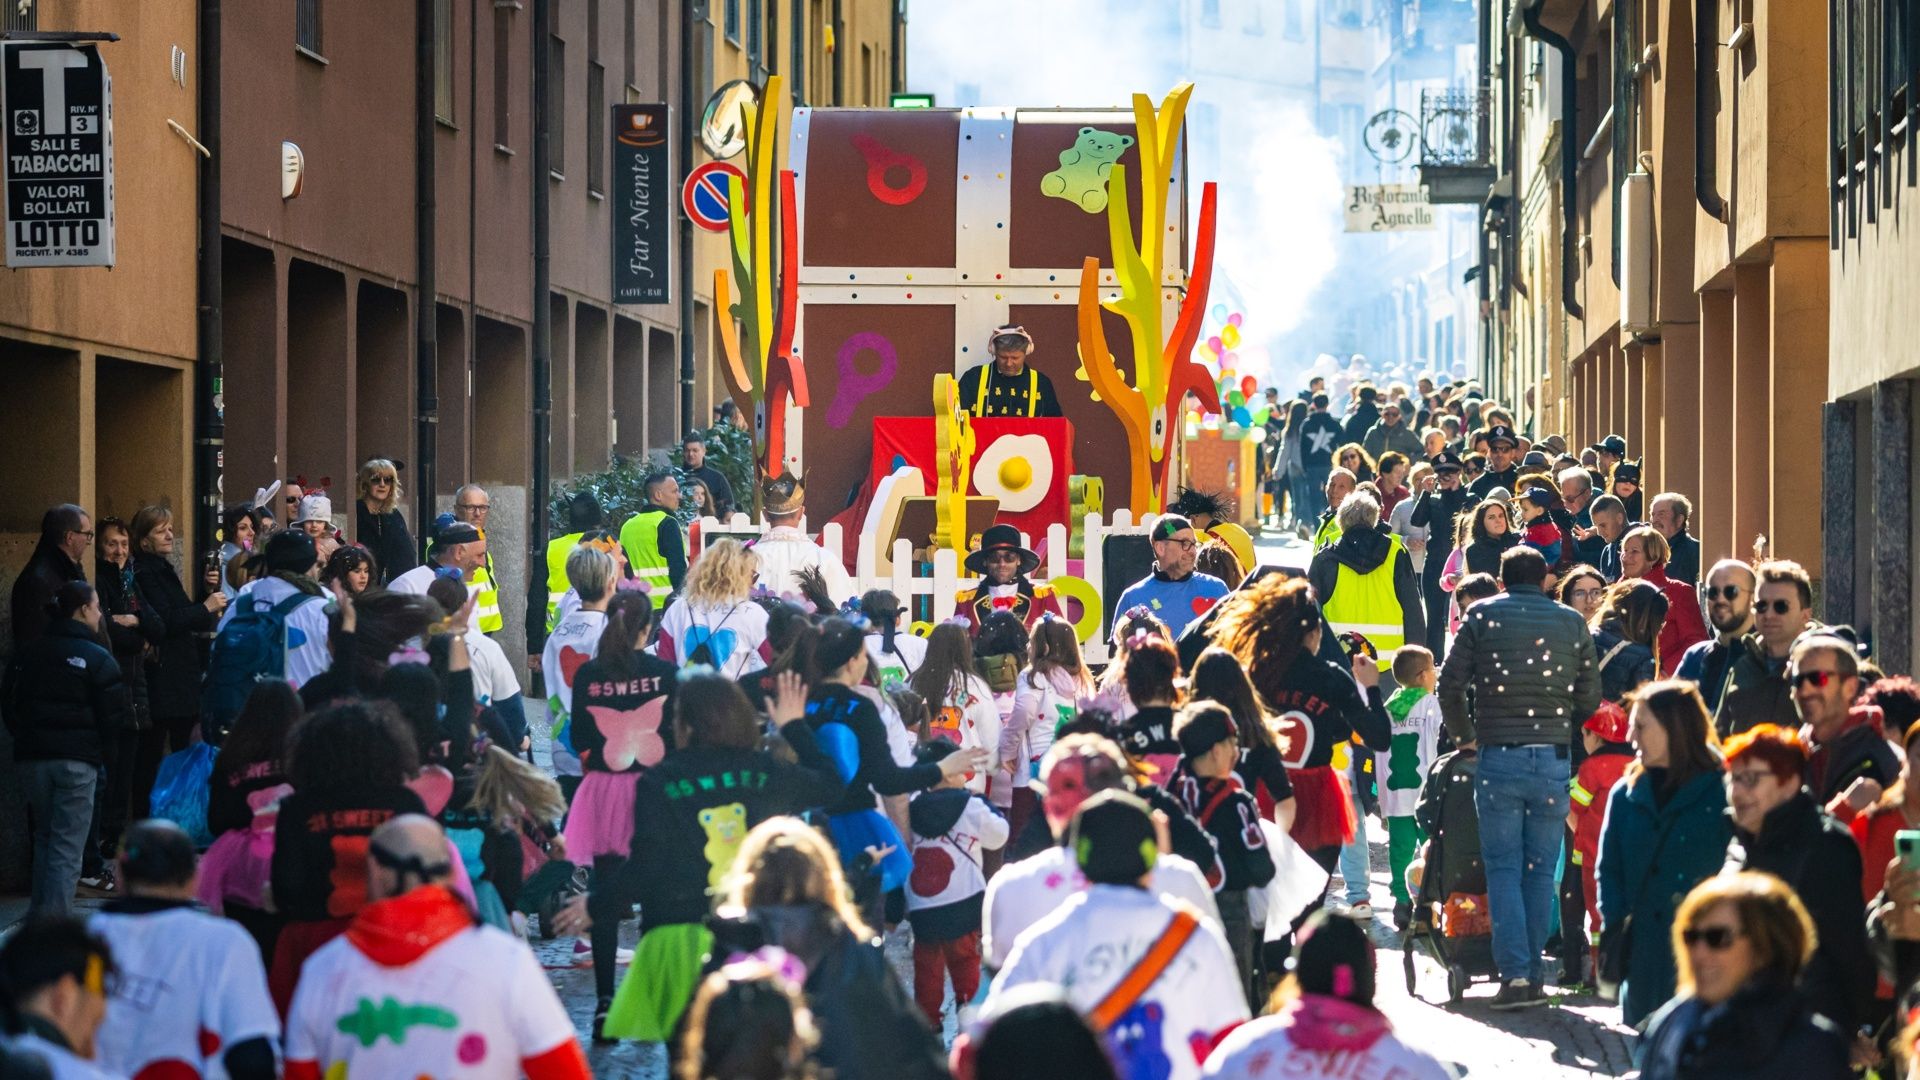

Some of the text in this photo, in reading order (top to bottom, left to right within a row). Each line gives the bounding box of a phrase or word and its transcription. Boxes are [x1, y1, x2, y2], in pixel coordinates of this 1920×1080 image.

[19, 50, 88, 135] T
[70, 105, 87, 113] RIV.
[76, 117, 88, 131] 3
[31, 139, 80, 151] SALI E
[11, 154, 100, 173] TABACCHI
[27, 185, 85, 199] VALORI
[23, 201, 90, 215] BOLLATI
[630, 153, 654, 278] Far Niente
[1371, 203, 1432, 232] Agnello
[15, 220, 100, 248] LOTTO
[15, 249, 52, 257] RICEVIT.
[66, 248, 89, 256] 4385
[647, 287, 662, 297] BAR
[588, 676, 662, 698] #SWEET
